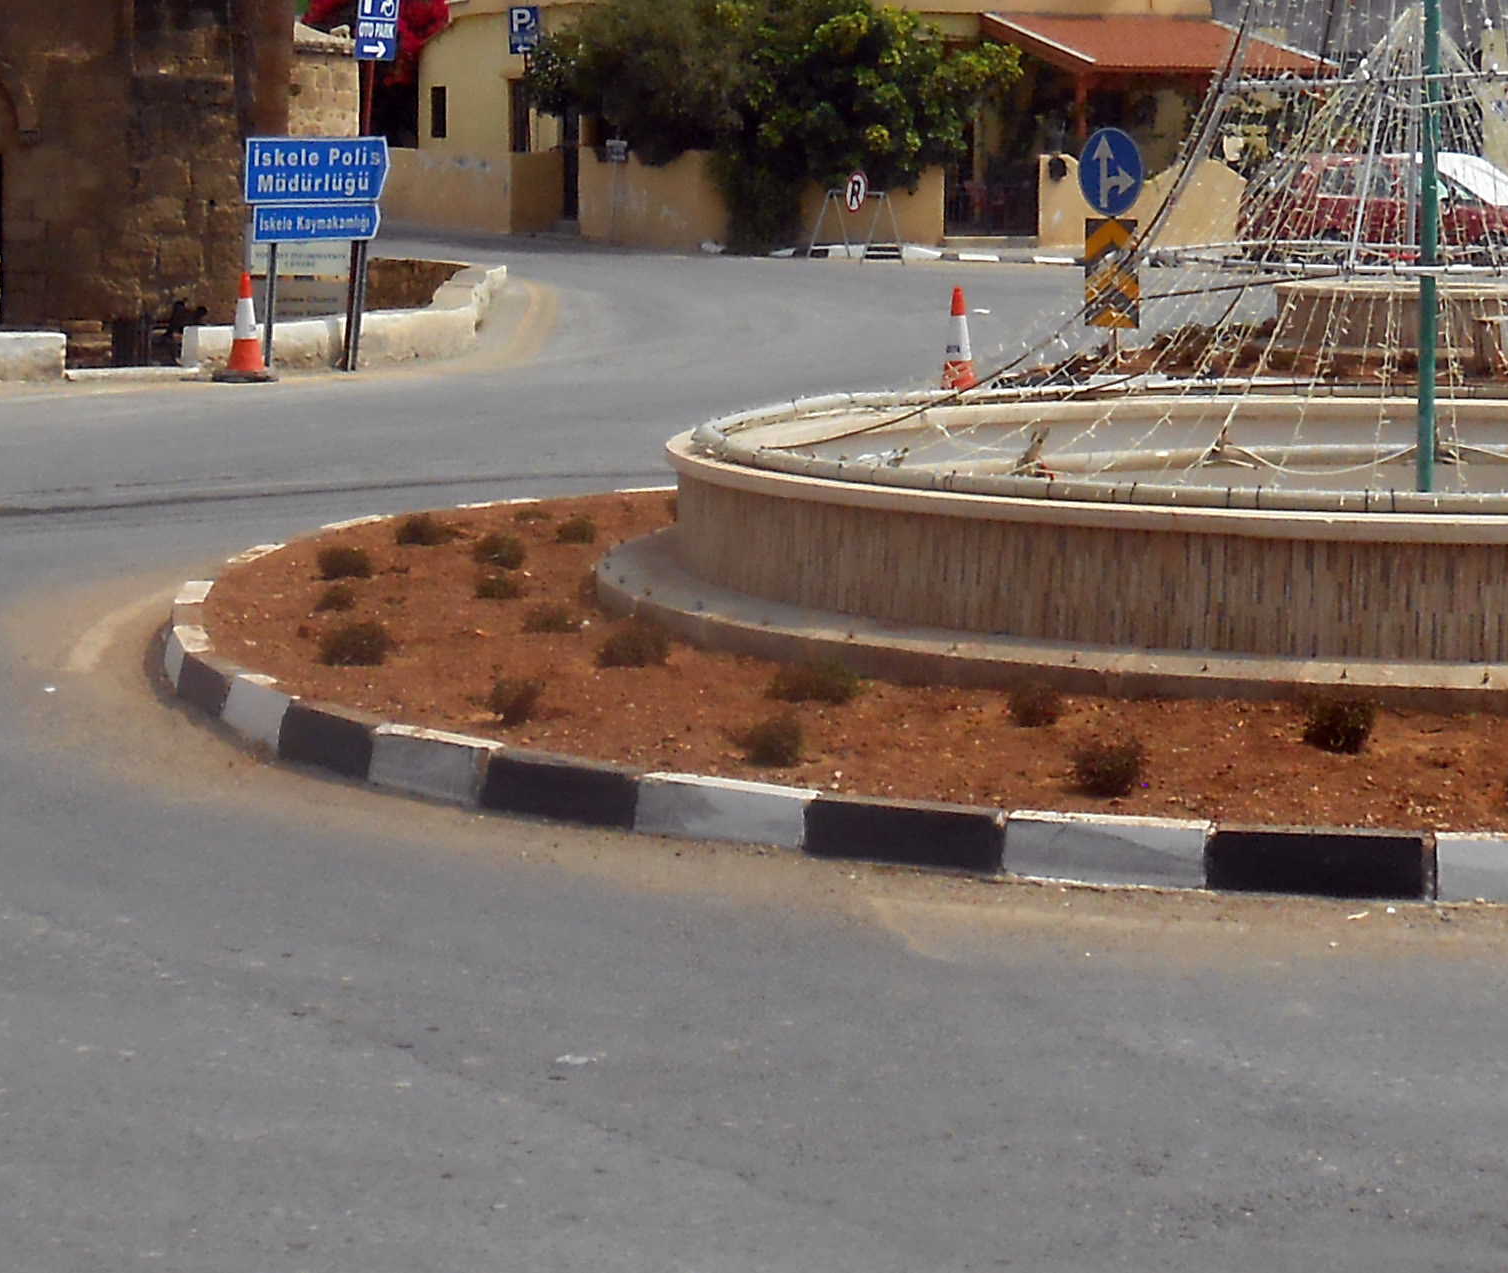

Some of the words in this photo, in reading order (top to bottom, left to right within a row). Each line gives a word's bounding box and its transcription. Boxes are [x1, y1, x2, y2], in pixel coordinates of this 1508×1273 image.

[358, 22, 375, 38] OTO
[375, 24, 394, 39] PARK
[512, 9, 530, 32] P
[254, 143, 320, 168] İskele
[329, 146, 381, 167] Polis
[257, 171, 369, 196] Müdürlüğü
